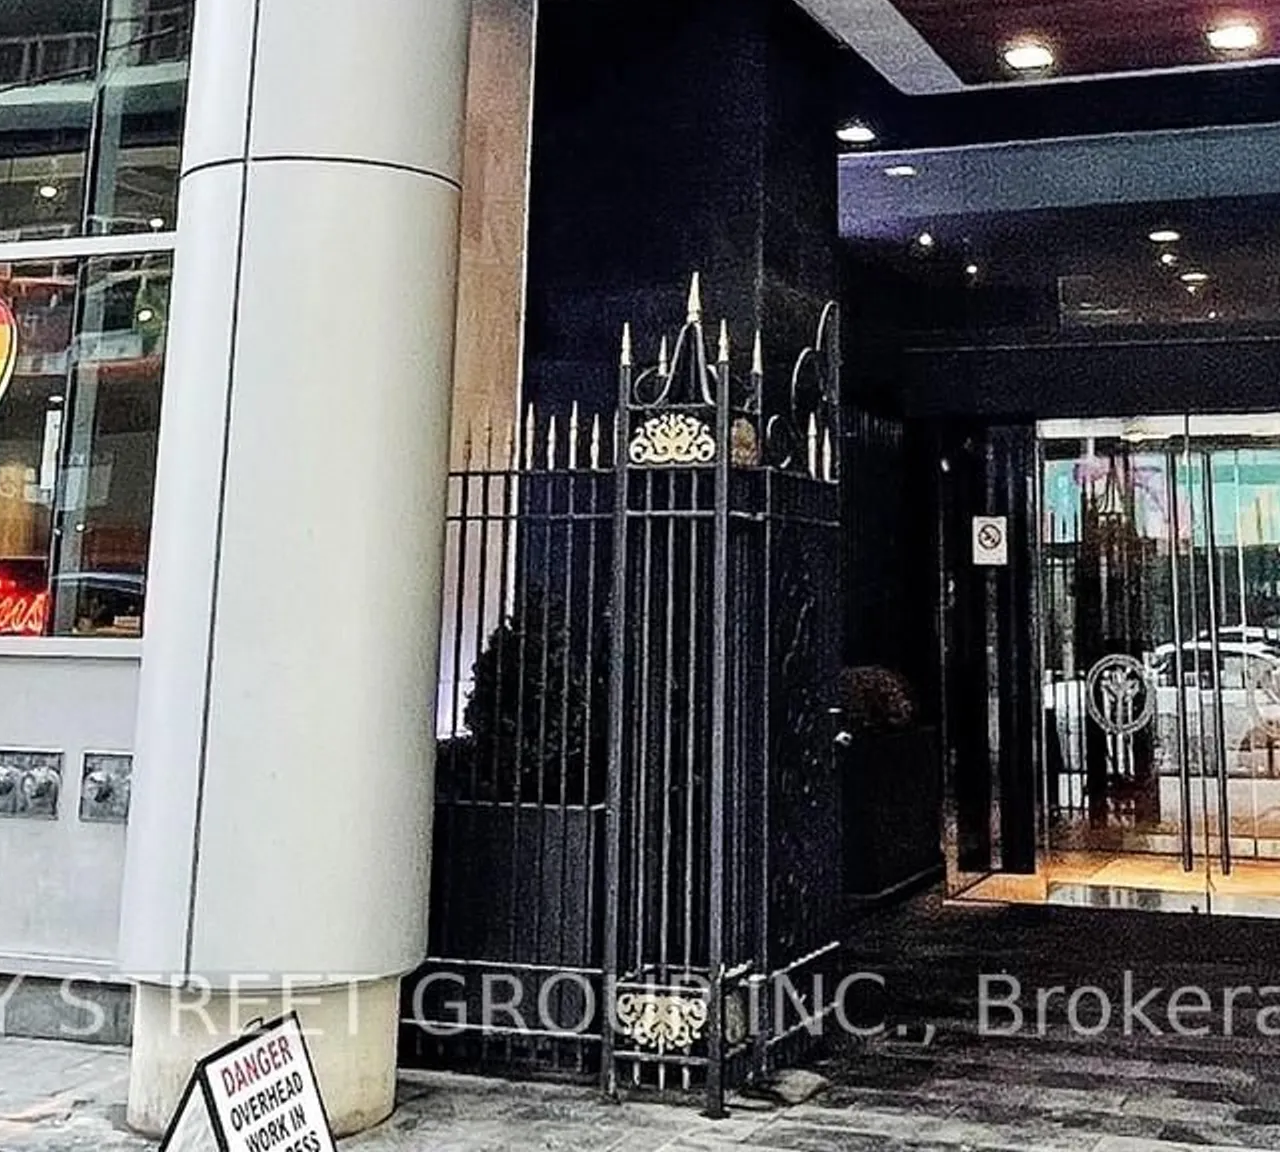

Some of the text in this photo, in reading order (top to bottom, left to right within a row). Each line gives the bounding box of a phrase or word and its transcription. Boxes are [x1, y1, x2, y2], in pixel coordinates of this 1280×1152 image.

[221, 1035, 294, 1097] DANGER
[230, 1071, 303, 1132] OVERHEAD
[244, 1103, 307, 1152] WORK IN
